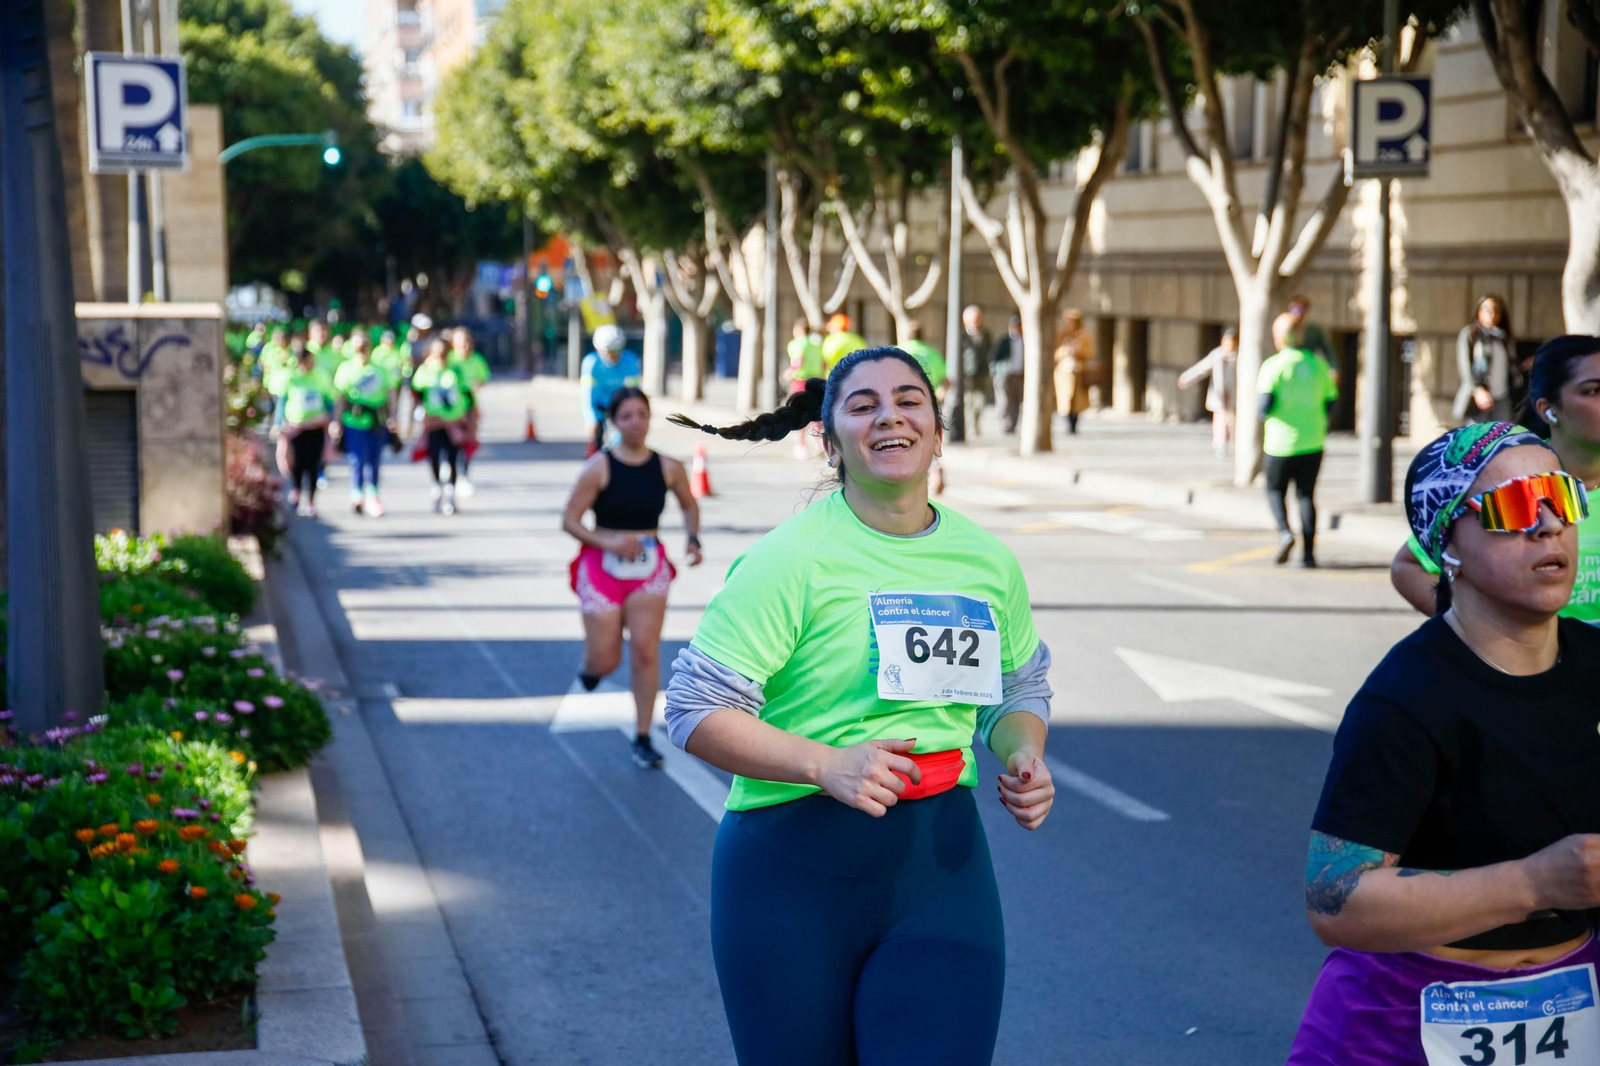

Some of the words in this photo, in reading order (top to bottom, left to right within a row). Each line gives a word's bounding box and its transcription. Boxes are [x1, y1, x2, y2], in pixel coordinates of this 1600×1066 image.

[97, 62, 177, 150] P
[1358, 82, 1426, 162] P
[876, 596, 913, 606] Almería
[878, 607, 909, 617] contra
[911, 607, 920, 615] el
[921, 608, 950, 617] cáncer
[905, 626, 980, 668] 642
[953, 688, 973, 697] febrero
[1431, 1001, 1469, 1012] contra
[1473, 1000, 1485, 1011] el
[1488, 998, 1529, 1011] cáncer
[1459, 1016, 1570, 1066] 314
